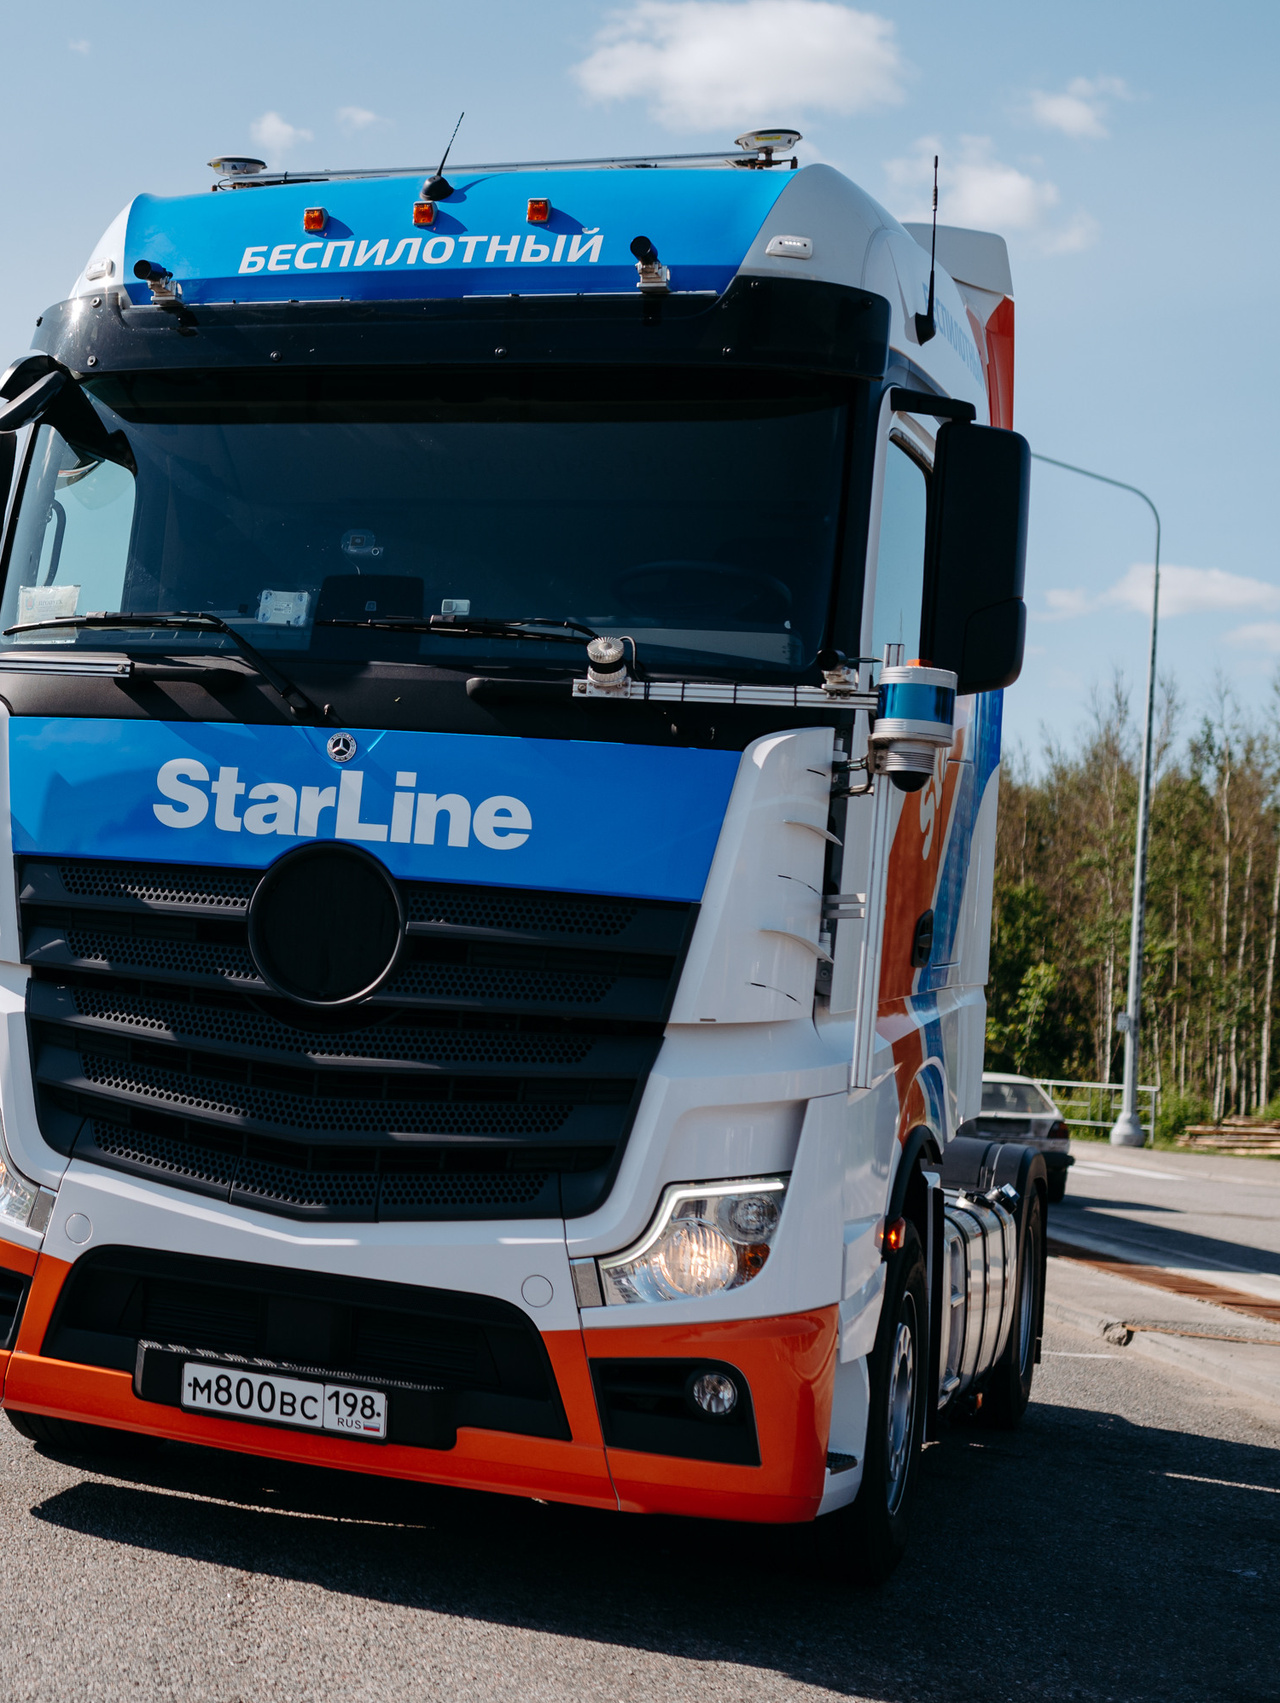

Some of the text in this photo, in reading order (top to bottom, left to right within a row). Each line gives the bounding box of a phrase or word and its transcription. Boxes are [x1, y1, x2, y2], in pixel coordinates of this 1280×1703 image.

[238, 227, 604, 274] БЕСПИЛОТНЫЙ
[153, 758, 532, 850] StarLine
[327, 1390, 376, 1420] 198
[337, 1417, 362, 1430] RUS
